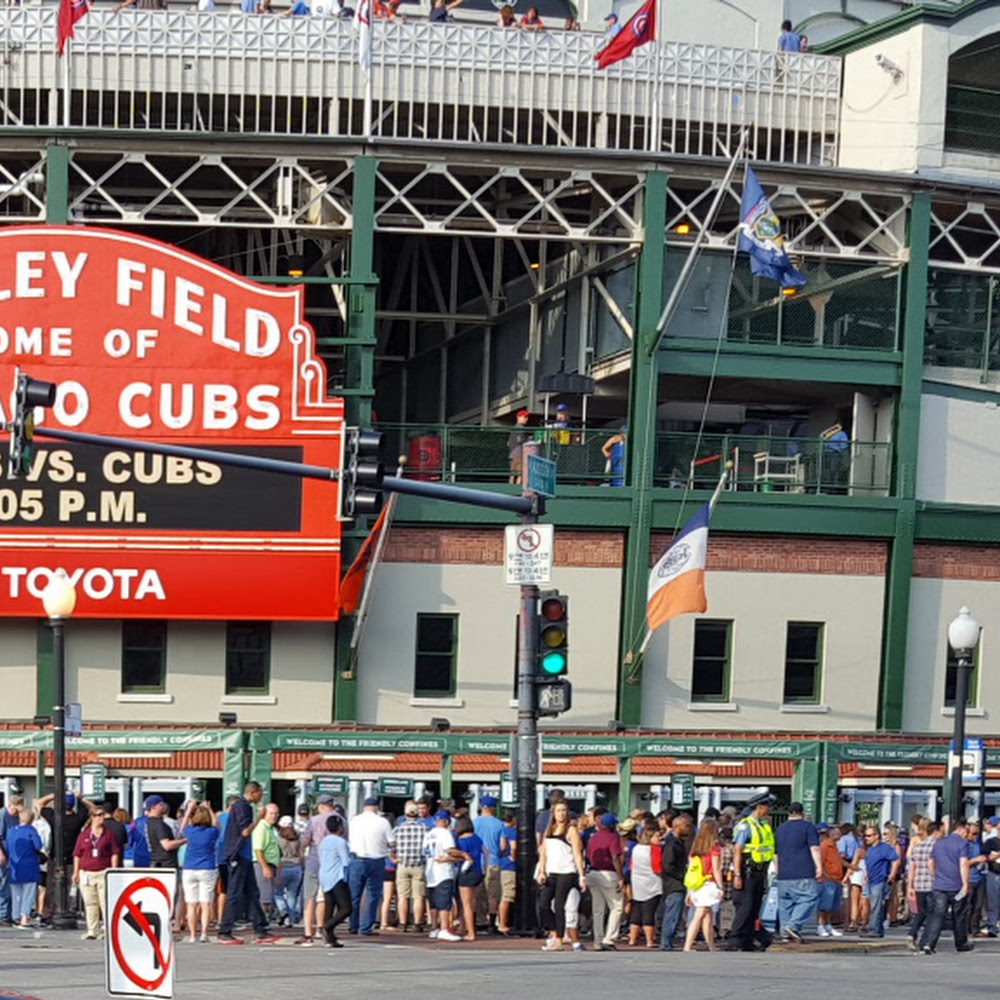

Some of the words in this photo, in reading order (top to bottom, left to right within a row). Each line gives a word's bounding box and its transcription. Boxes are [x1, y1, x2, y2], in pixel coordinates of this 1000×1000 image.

[116, 257, 281, 358] FIELD
[103, 328, 159, 358] OF
[118, 382, 281, 430] CUBS
[102, 450, 222, 486] CUBS
[58, 489, 147, 523] P.M.
[1, 566, 166, 601] TOYOTA
[97, 737, 109, 746] TO
[285, 738, 326, 747] WELCOME
[328, 739, 339, 747] TO
[341, 739, 357, 748] THE
[467, 742, 508, 750] WELCOME
[542, 743, 576, 751] RIENDLY
[645, 744, 685, 752] WELCOME
[686, 745, 698, 753] TO
